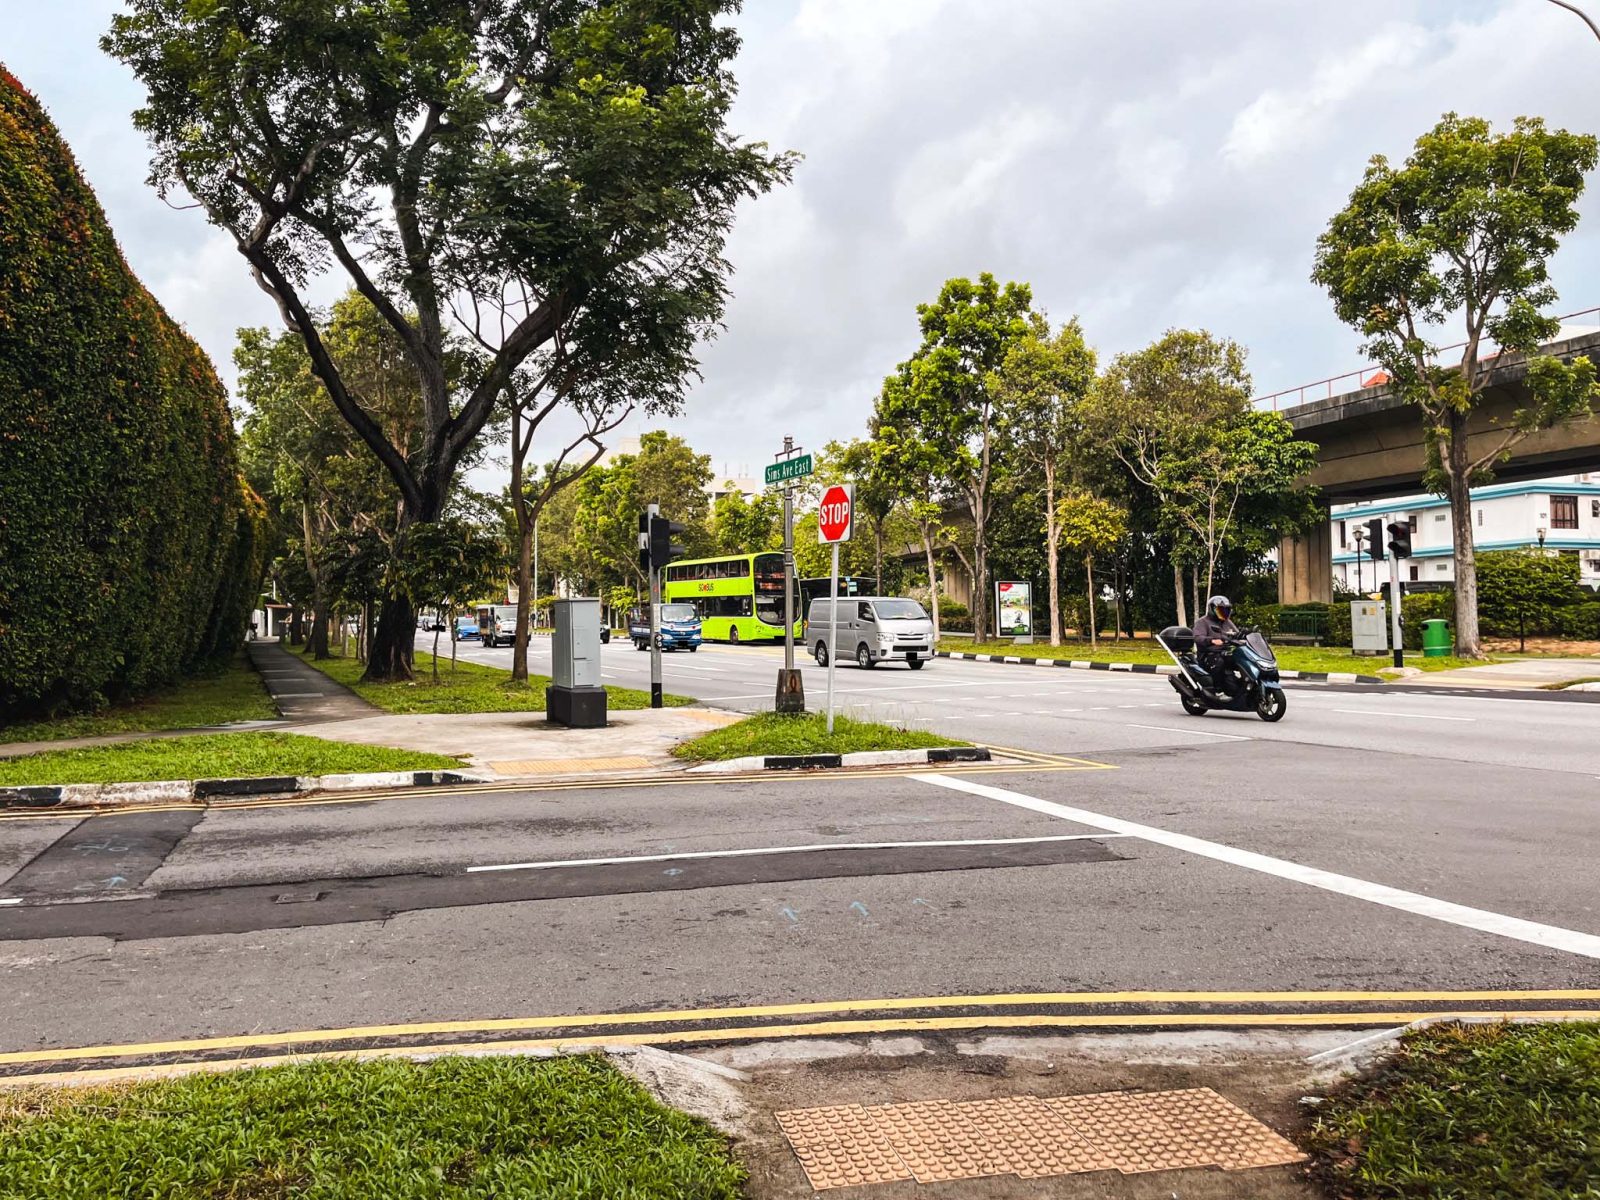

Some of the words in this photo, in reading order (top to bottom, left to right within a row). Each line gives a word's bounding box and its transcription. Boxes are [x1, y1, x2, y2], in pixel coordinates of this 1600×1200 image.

[767, 467, 780, 482] Sims
[782, 464, 793, 477] Ave
[795, 460, 809, 474] East
[820, 502, 849, 525] STOP
